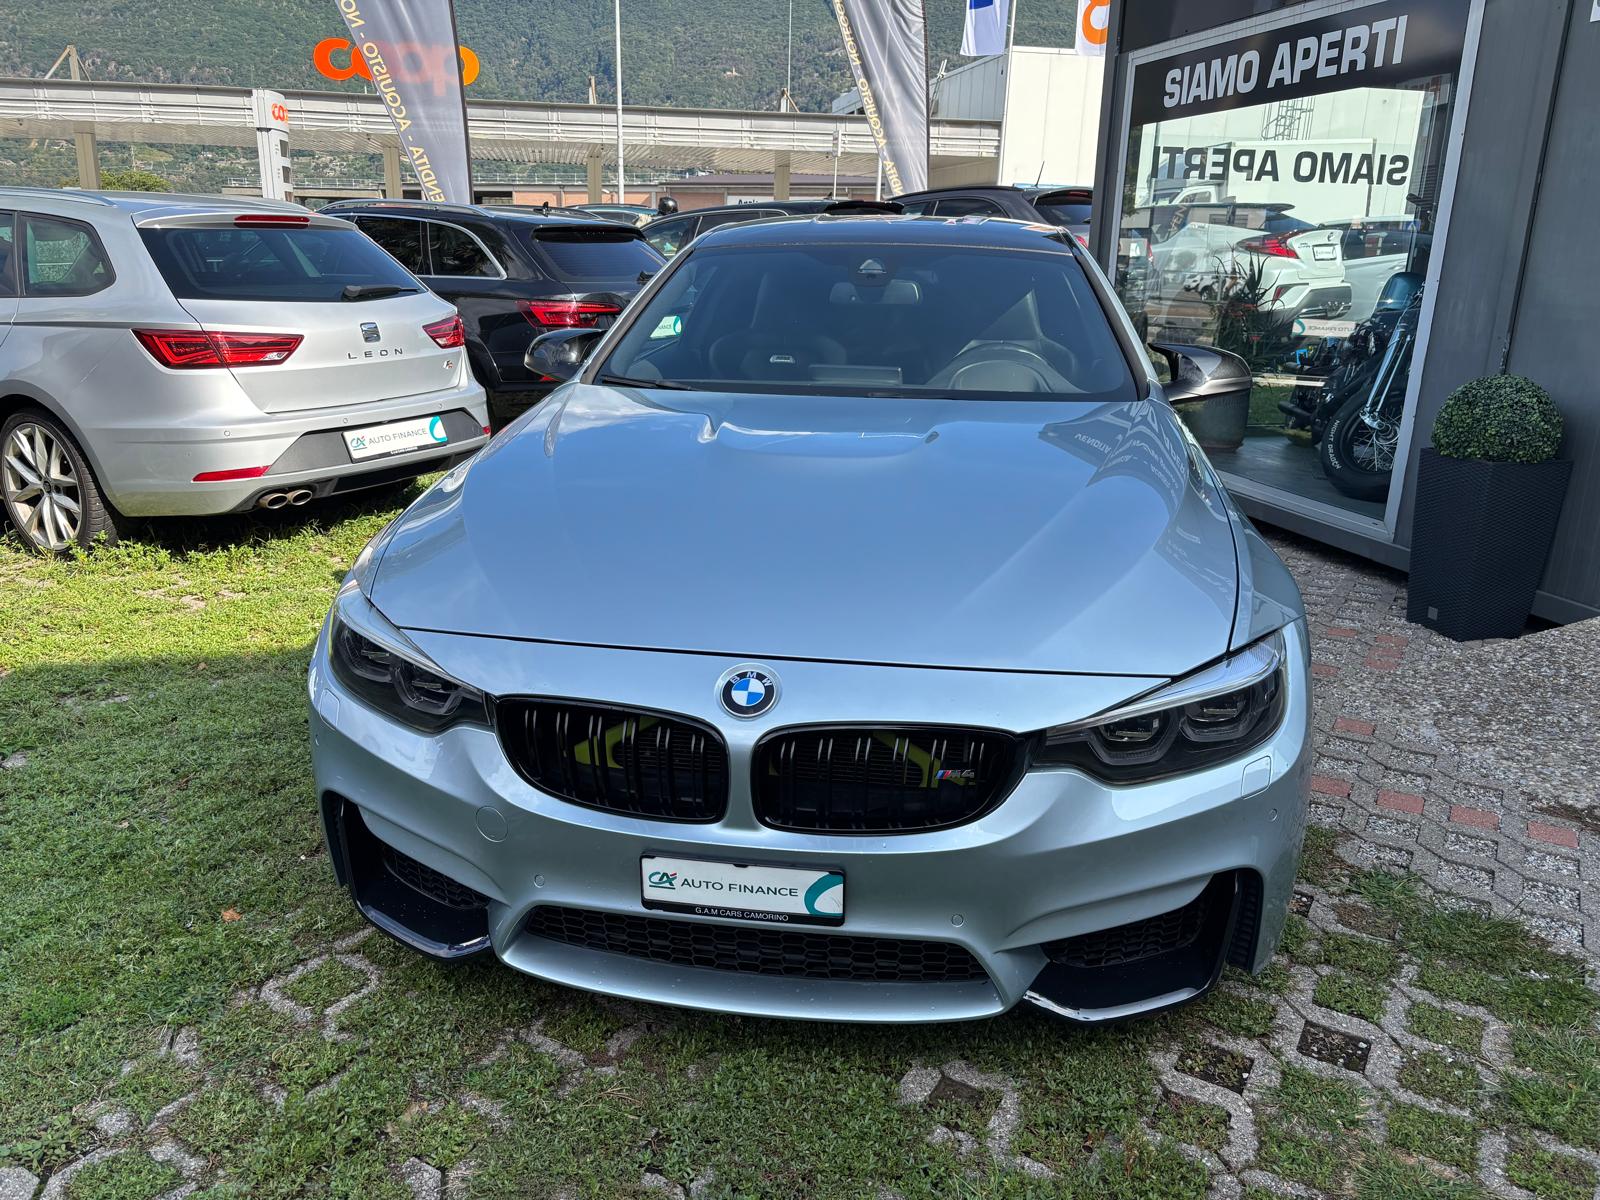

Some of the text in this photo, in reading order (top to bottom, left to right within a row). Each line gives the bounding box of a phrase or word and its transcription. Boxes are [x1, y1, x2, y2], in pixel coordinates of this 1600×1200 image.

[1163, 15, 1408, 109] SIAMO APERTI
[348, 348, 403, 359] LEON
[368, 434, 392, 445] AUTO
[392, 427, 428, 440] FINANCE
[730, 671, 773, 687] BMW
[681, 878, 724, 891] AUTO
[728, 883, 799, 897] FINANCE
[719, 909, 742, 919] CARS
[744, 911, 789, 922] CAMORINO
